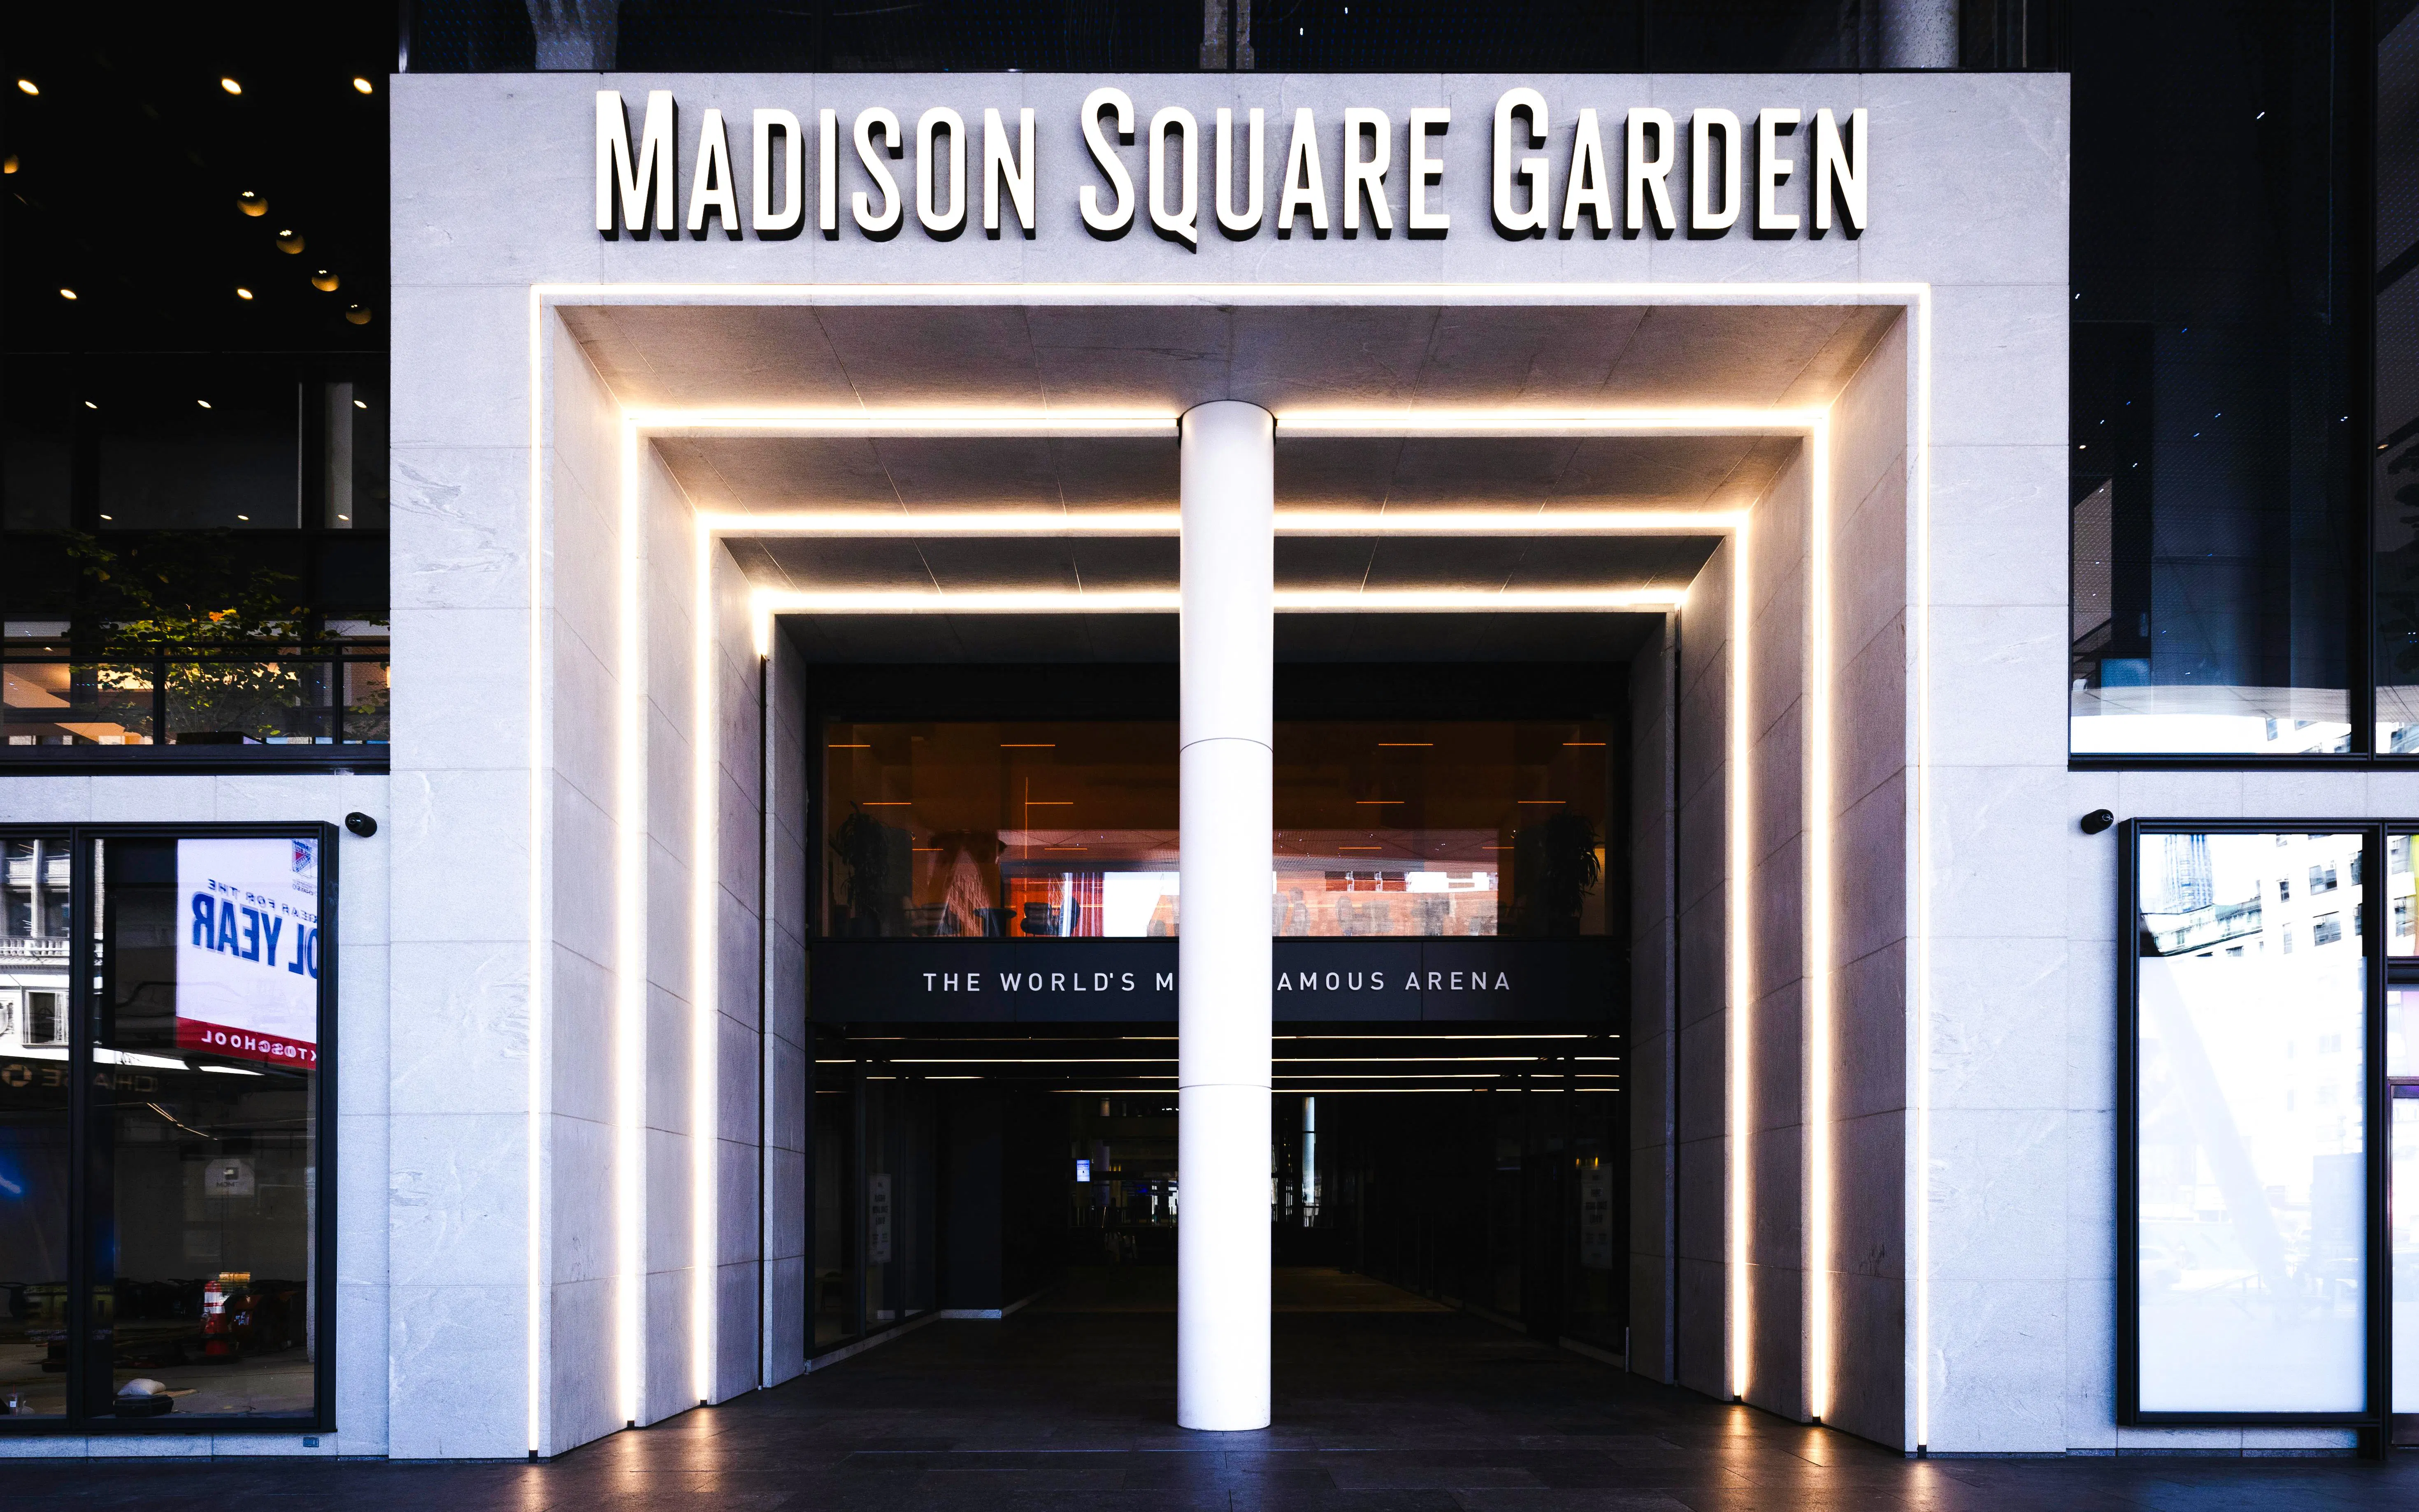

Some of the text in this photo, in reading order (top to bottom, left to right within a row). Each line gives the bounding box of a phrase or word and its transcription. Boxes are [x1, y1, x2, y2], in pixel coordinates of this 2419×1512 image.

[596, 87, 1867, 252] MADISON SQUARE GARDEN
[923, 973, 981, 991] THE
[1000, 972, 1135, 991] WORLD'S
[1277, 971, 1385, 991] AMOUS
[1405, 971, 1510, 990] ARENA
